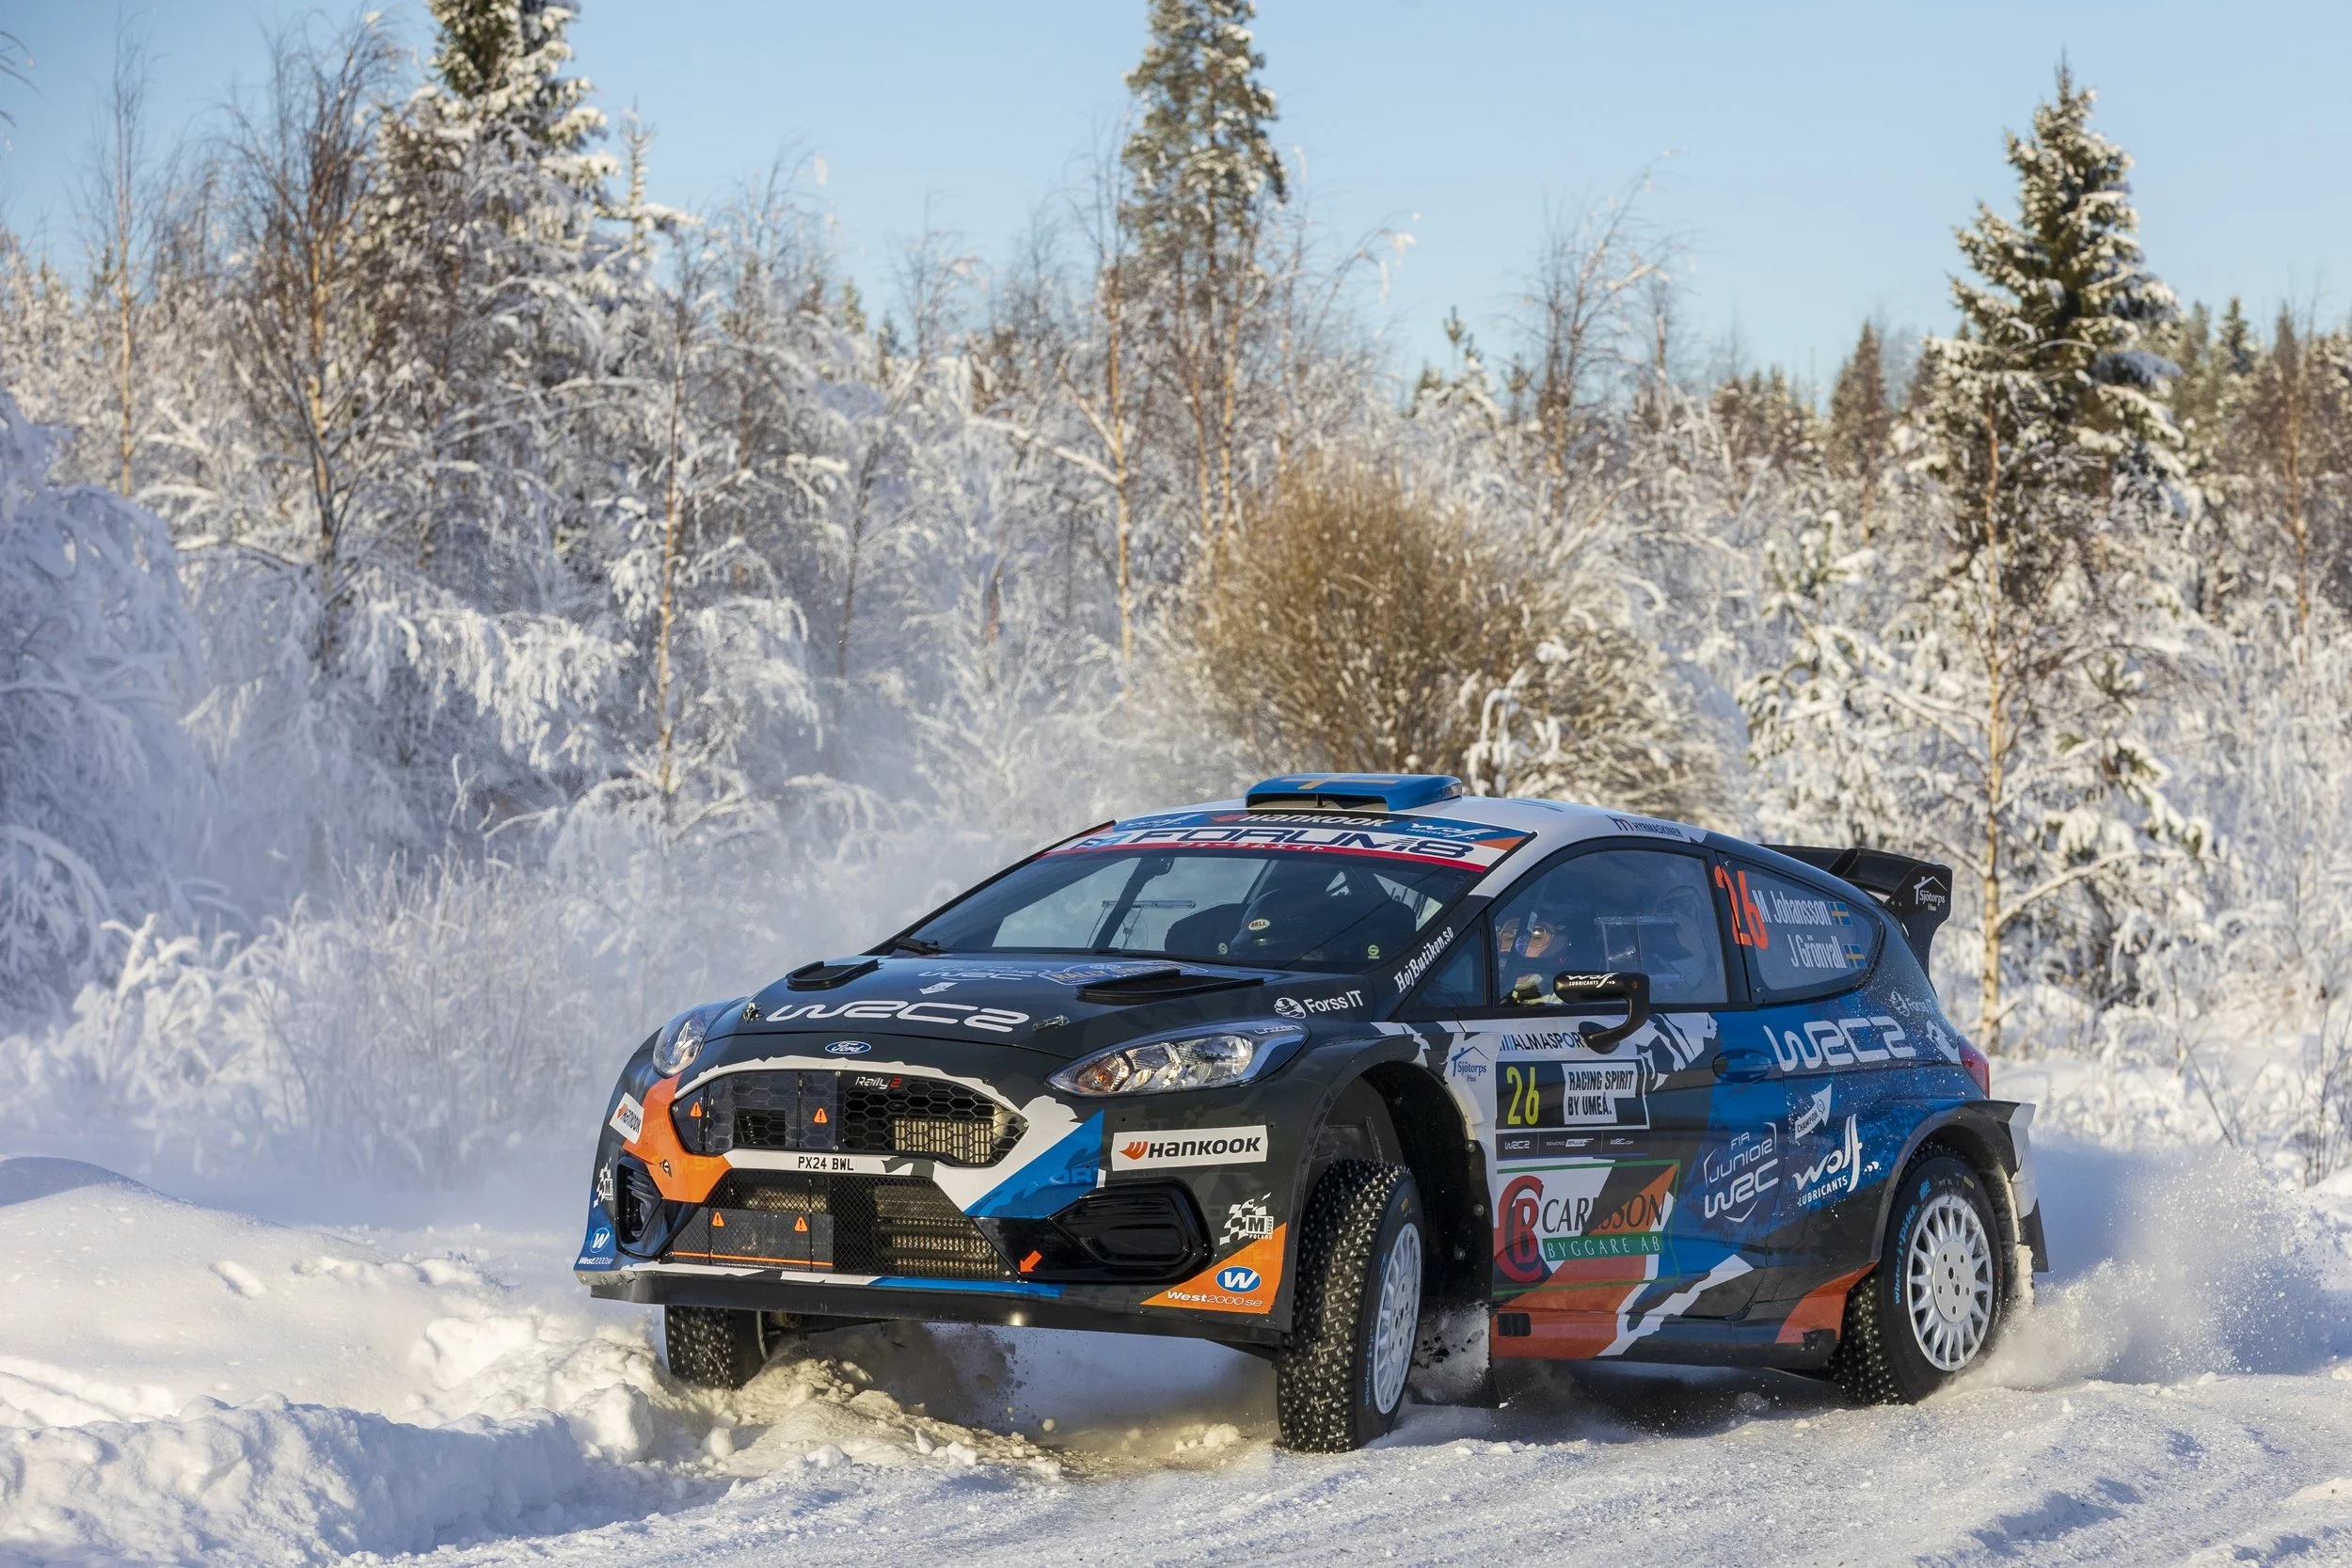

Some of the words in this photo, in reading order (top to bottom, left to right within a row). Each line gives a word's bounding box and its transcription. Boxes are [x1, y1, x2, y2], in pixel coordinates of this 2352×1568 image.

[1714, 864, 1769, 949] 26
[1752, 889, 1772, 924] M
[1771, 892, 1834, 927] Johansson
[1788, 933, 1800, 968] J
[1796, 935, 1847, 969] Grönvall
[1304, 995, 1349, 1014] Forss
[1348, 990, 1364, 1008] IT
[765, 1000, 1030, 1033] WRC2
[831, 1040, 865, 1053] Ford
[1512, 1031, 1585, 1052] ALMASPOR
[1762, 1015, 1917, 1072] WRC2
[1457, 1061, 1487, 1075] Sjötorps
[1568, 1070, 1603, 1092] RACING
[1604, 1069, 1635, 1091] SPIRIT
[1506, 1066, 1541, 1126] 26
[1567, 1096, 1580, 1117] BY
[1582, 1091, 1613, 1117] UMEÅ.
[1797, 1109, 1819, 1133] CHAMPION
[1730, 1132, 1751, 1150] FIA
[798, 1156, 827, 1170] PX24
[832, 1158, 854, 1171] BWL
[1708, 1136, 1773, 1183] JUNIOR
[1704, 1158, 1779, 1219] WRC
[1798, 1175, 1849, 1207] LUBRICANTS
[1248, 1216, 1266, 1232] M
[592, 1232, 610, 1249] W
[1547, 1241, 1630, 1259] BYGGARE
[1641, 1234, 1661, 1252] AB
[1224, 1271, 1258, 1290] W
[1167, 1291, 1263, 1307] West2000.se
